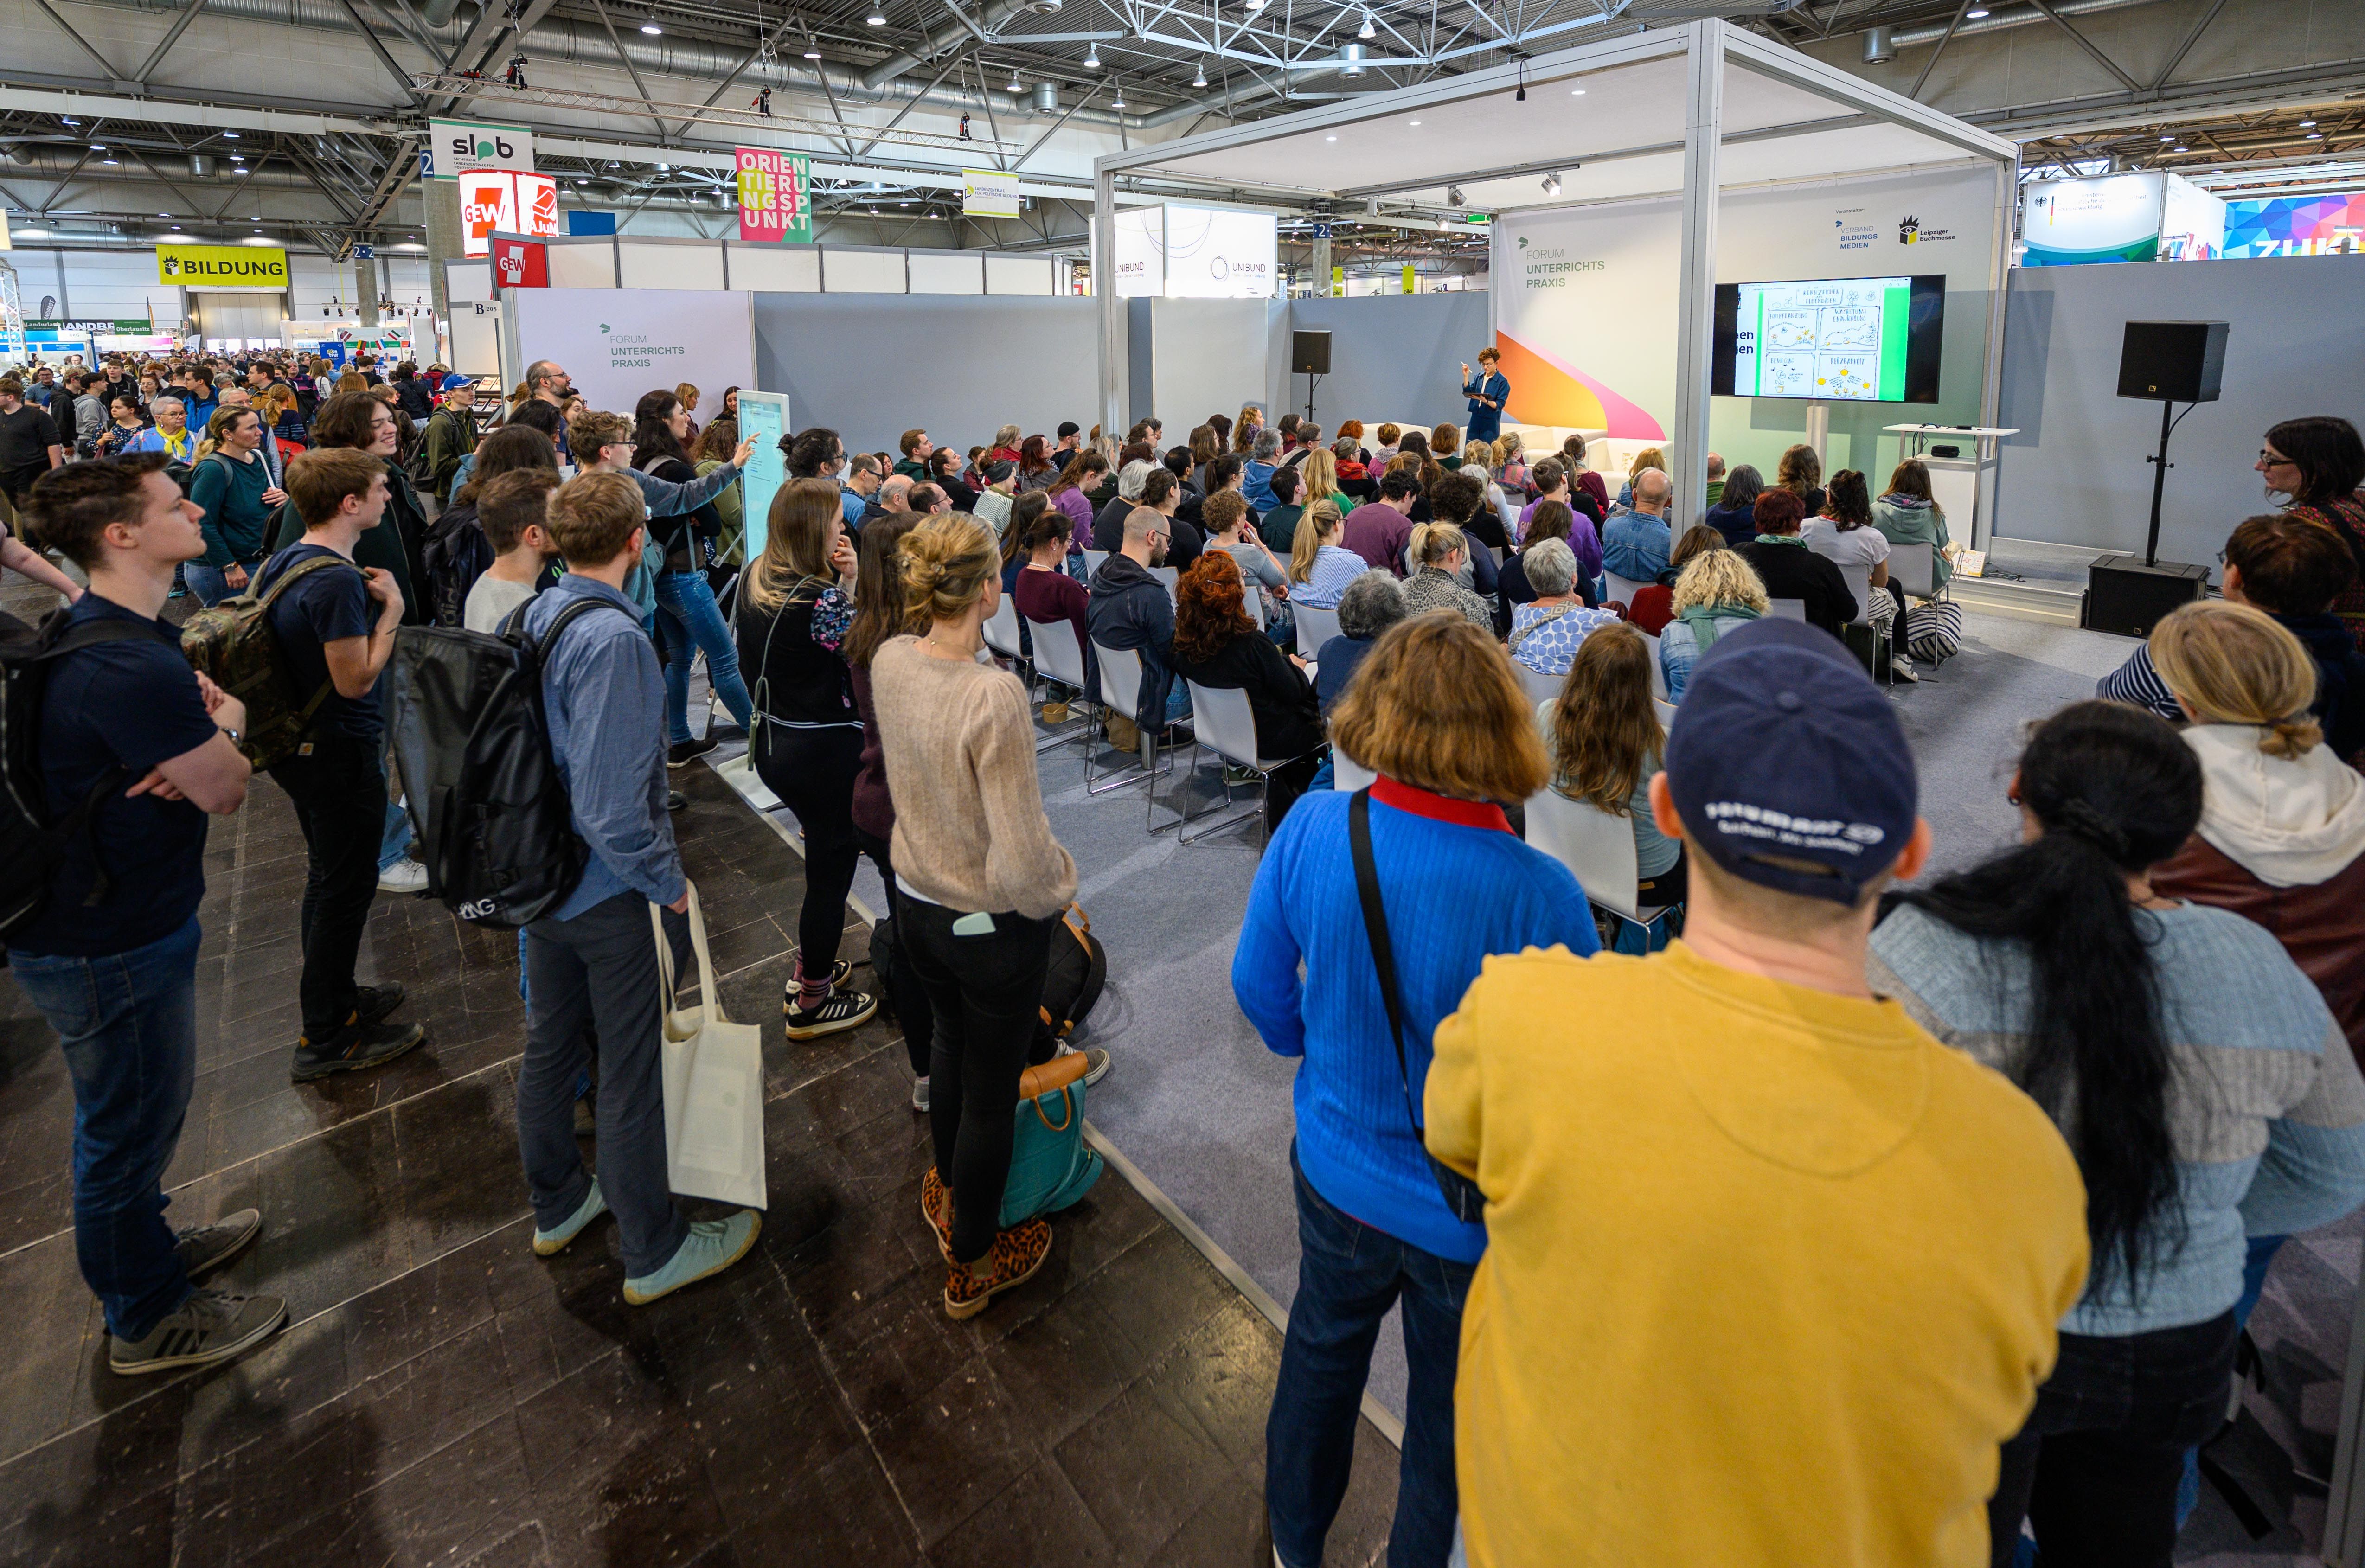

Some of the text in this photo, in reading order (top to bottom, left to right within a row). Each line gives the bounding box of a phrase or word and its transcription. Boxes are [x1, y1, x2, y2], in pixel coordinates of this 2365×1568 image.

[422, 153, 433, 174] 2
[741, 153, 806, 175] ORIEN
[741, 172, 807, 193] TIERU
[743, 191, 808, 211] NGSP
[465, 204, 505, 223] GEW
[744, 210, 809, 230] UNKT
[1319, 224, 1326, 237] 2
[354, 246, 374, 258] 2 2
[1527, 249, 1564, 260] FORUM
[183, 260, 283, 275] BILDUNG
[500, 257, 526, 272] GEW
[1115, 262, 1144, 273] UNIBUND
[1232, 263, 1265, 272] UNIBUND
[1527, 261, 1605, 274] UNTERRICHTS
[1526, 278, 1565, 288] PRAXIS
[475, 304, 484, 314] B
[610, 335, 647, 344] FORUM
[611, 346, 685, 356] UNTERRICHTS
[612, 359, 651, 367] PRAXIS
